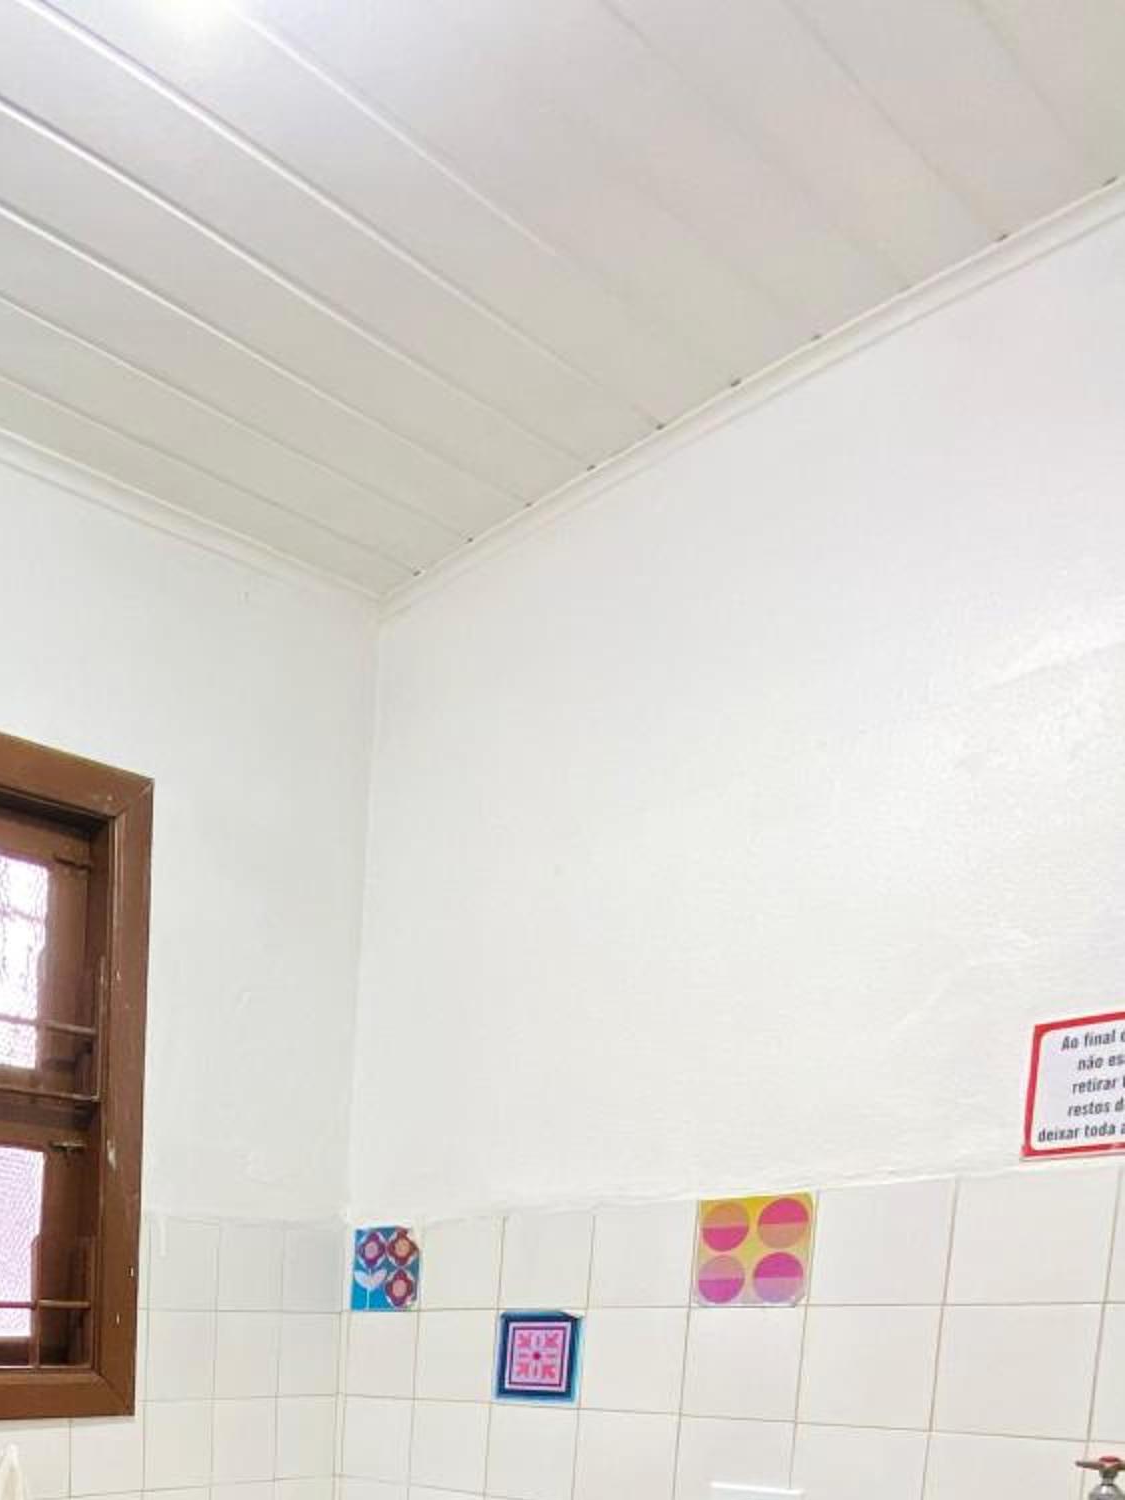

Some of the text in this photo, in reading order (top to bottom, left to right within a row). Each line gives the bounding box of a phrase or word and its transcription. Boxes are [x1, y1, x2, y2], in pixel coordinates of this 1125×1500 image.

[1061, 1035, 1079, 1051] Ao
[1084, 1028, 1116, 1047] final
[1077, 1055, 1104, 1071] não
[1072, 1077, 1117, 1094] retirar
[1067, 1101, 1110, 1117] restos
[1038, 1127, 1080, 1142] deixar
[1084, 1121, 1116, 1137] toda
